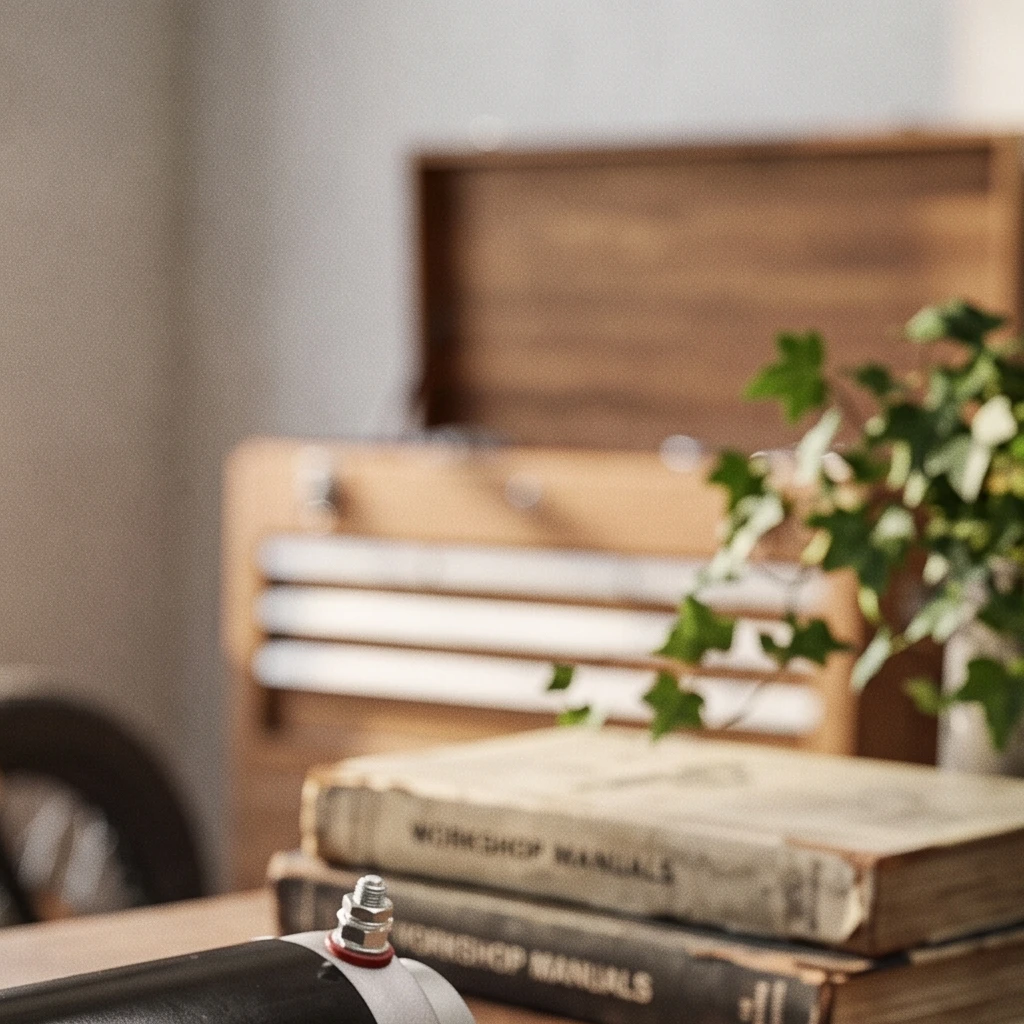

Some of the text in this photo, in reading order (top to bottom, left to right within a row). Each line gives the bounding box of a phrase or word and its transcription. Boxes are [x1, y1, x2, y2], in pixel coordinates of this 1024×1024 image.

[410, 822, 676, 886] WORKSHOP MANUALS
[529, 950, 654, 1005] MANUALS
